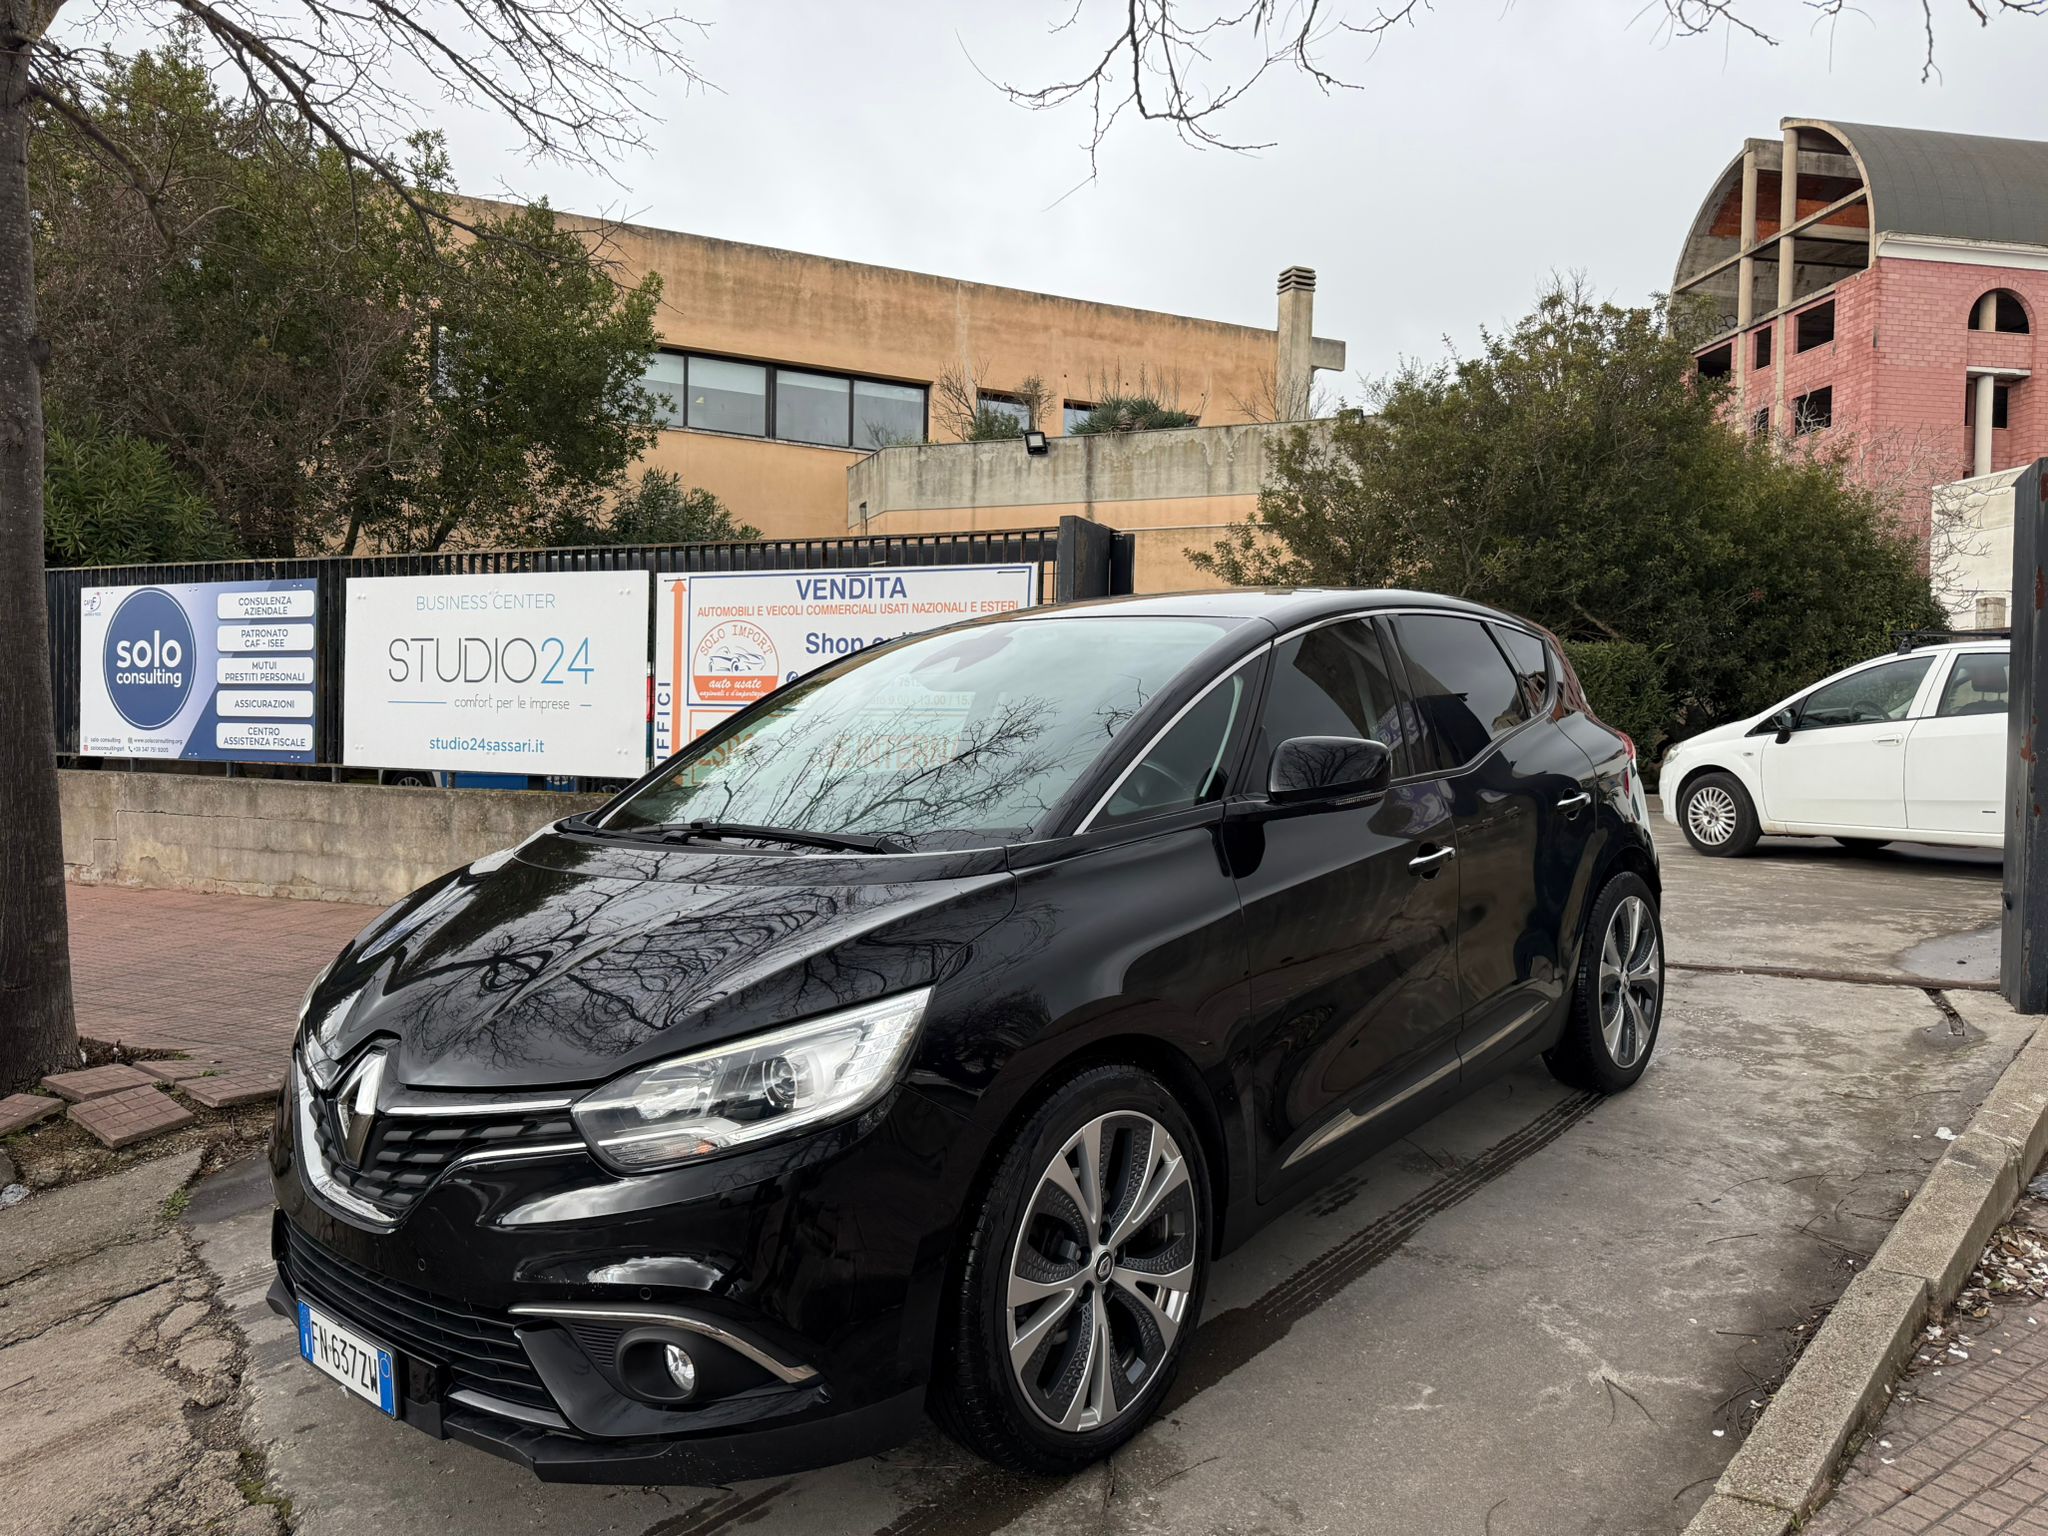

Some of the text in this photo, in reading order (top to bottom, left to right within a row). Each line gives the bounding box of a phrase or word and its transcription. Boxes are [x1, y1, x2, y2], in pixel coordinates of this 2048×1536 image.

[796, 576, 907, 600] VENDITA
[238, 596, 292, 606] CONSULENZA
[416, 593, 556, 611] BUSINESS CENTER
[244, 606, 288, 616] AZIENDALE
[697, 600, 1018, 617] AUTOMOBILI E VEICOLI COMMERCIALI USATI NAZIONALI E ESTERI
[241, 628, 288, 638] PATRONATO
[700, 624, 774, 656] SOLO IMPORT
[116, 630, 182, 668] solo
[244, 640, 260, 648] CAF
[268, 638, 284, 648] ISEE
[805, 632, 864, 655] Shop
[252, 661, 277, 670] MUTUI
[388, 636, 594, 685] STUDIO24
[116, 669, 182, 688] consulting
[224, 672, 305, 682] PRESTITI PERSONALI
[708, 678, 762, 688] auto usate
[234, 700, 295, 708] ASSICURAZIONI
[454, 694, 570, 714] comfort per le imprese
[247, 727, 280, 736] CENTRO
[223, 736, 306, 747] ASSISTENZA FISCALE
[429, 736, 544, 753] studio24sassari.it
